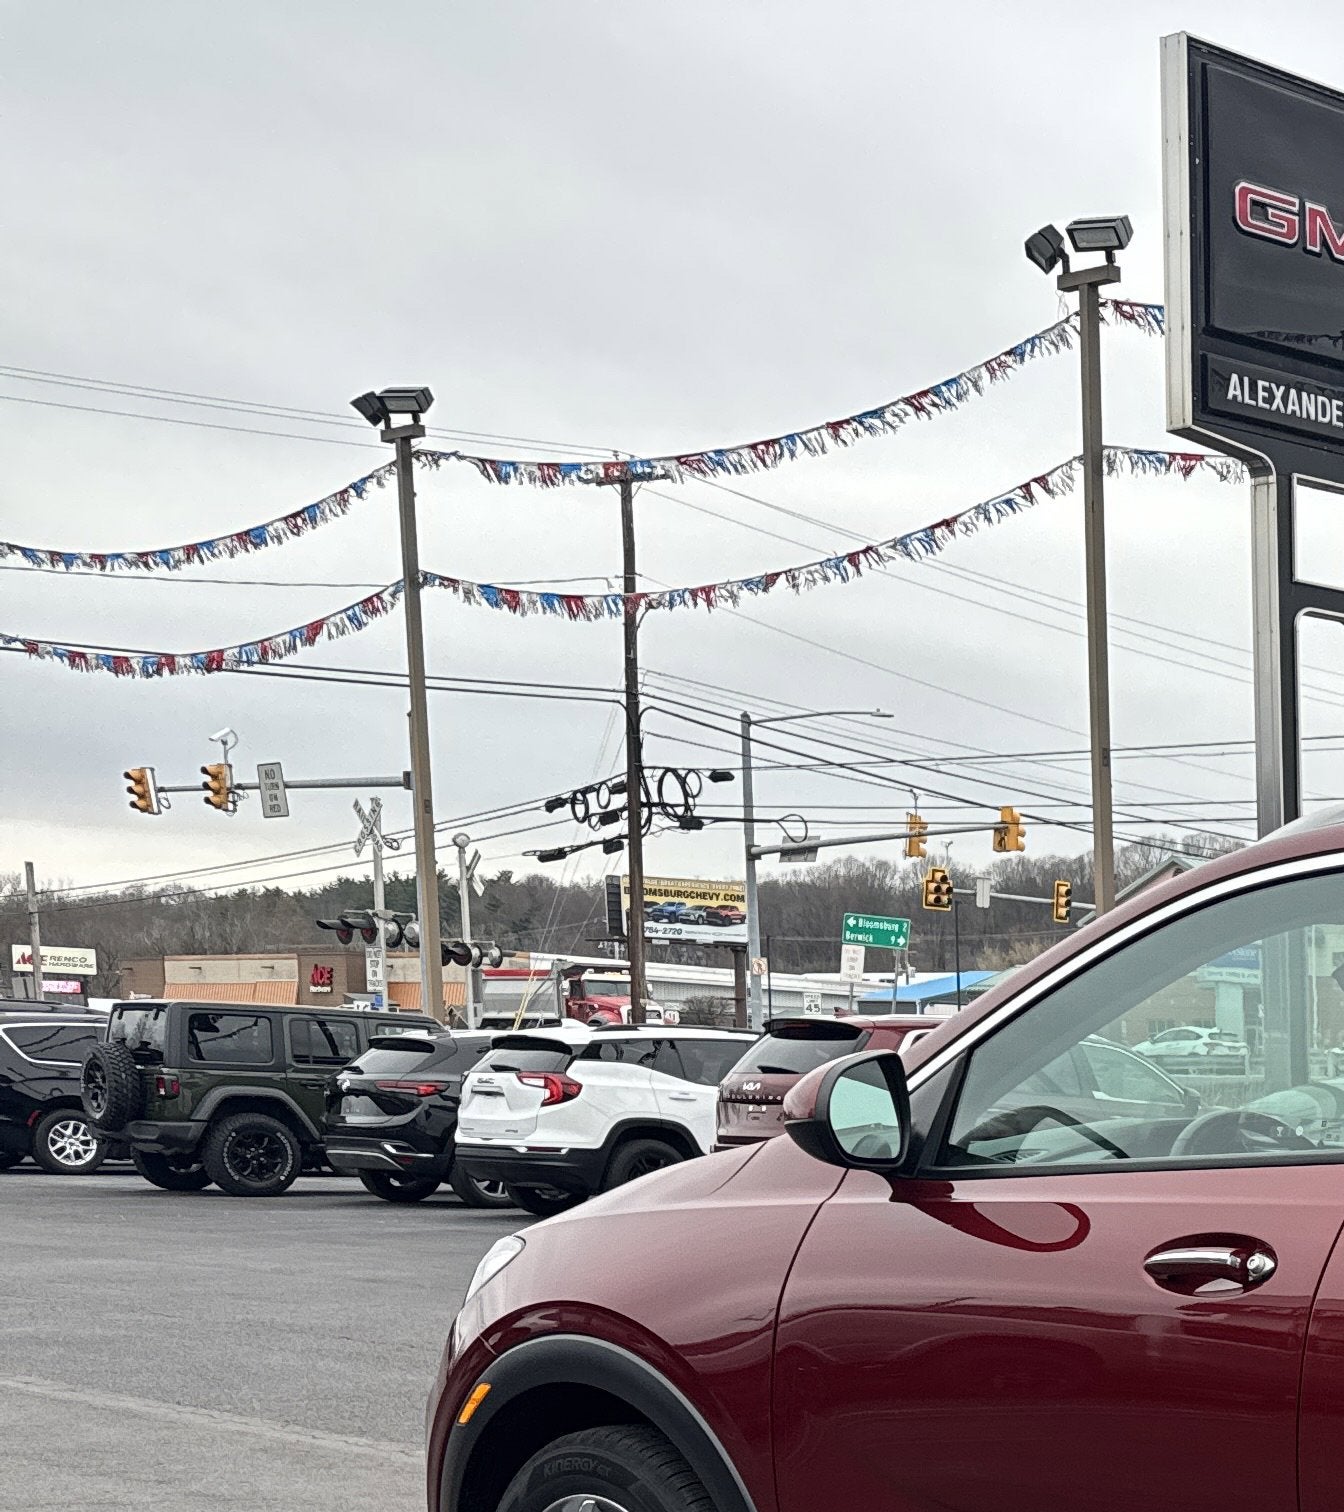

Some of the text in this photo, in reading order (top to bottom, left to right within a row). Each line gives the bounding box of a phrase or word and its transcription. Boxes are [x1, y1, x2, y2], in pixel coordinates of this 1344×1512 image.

[264, 769, 276, 780] NO
[902, 922, 908, 933] 2
[845, 930, 896, 945] Berwick 9
[310, 963, 334, 987] ACE
[805, 1003, 821, 1013] 45
